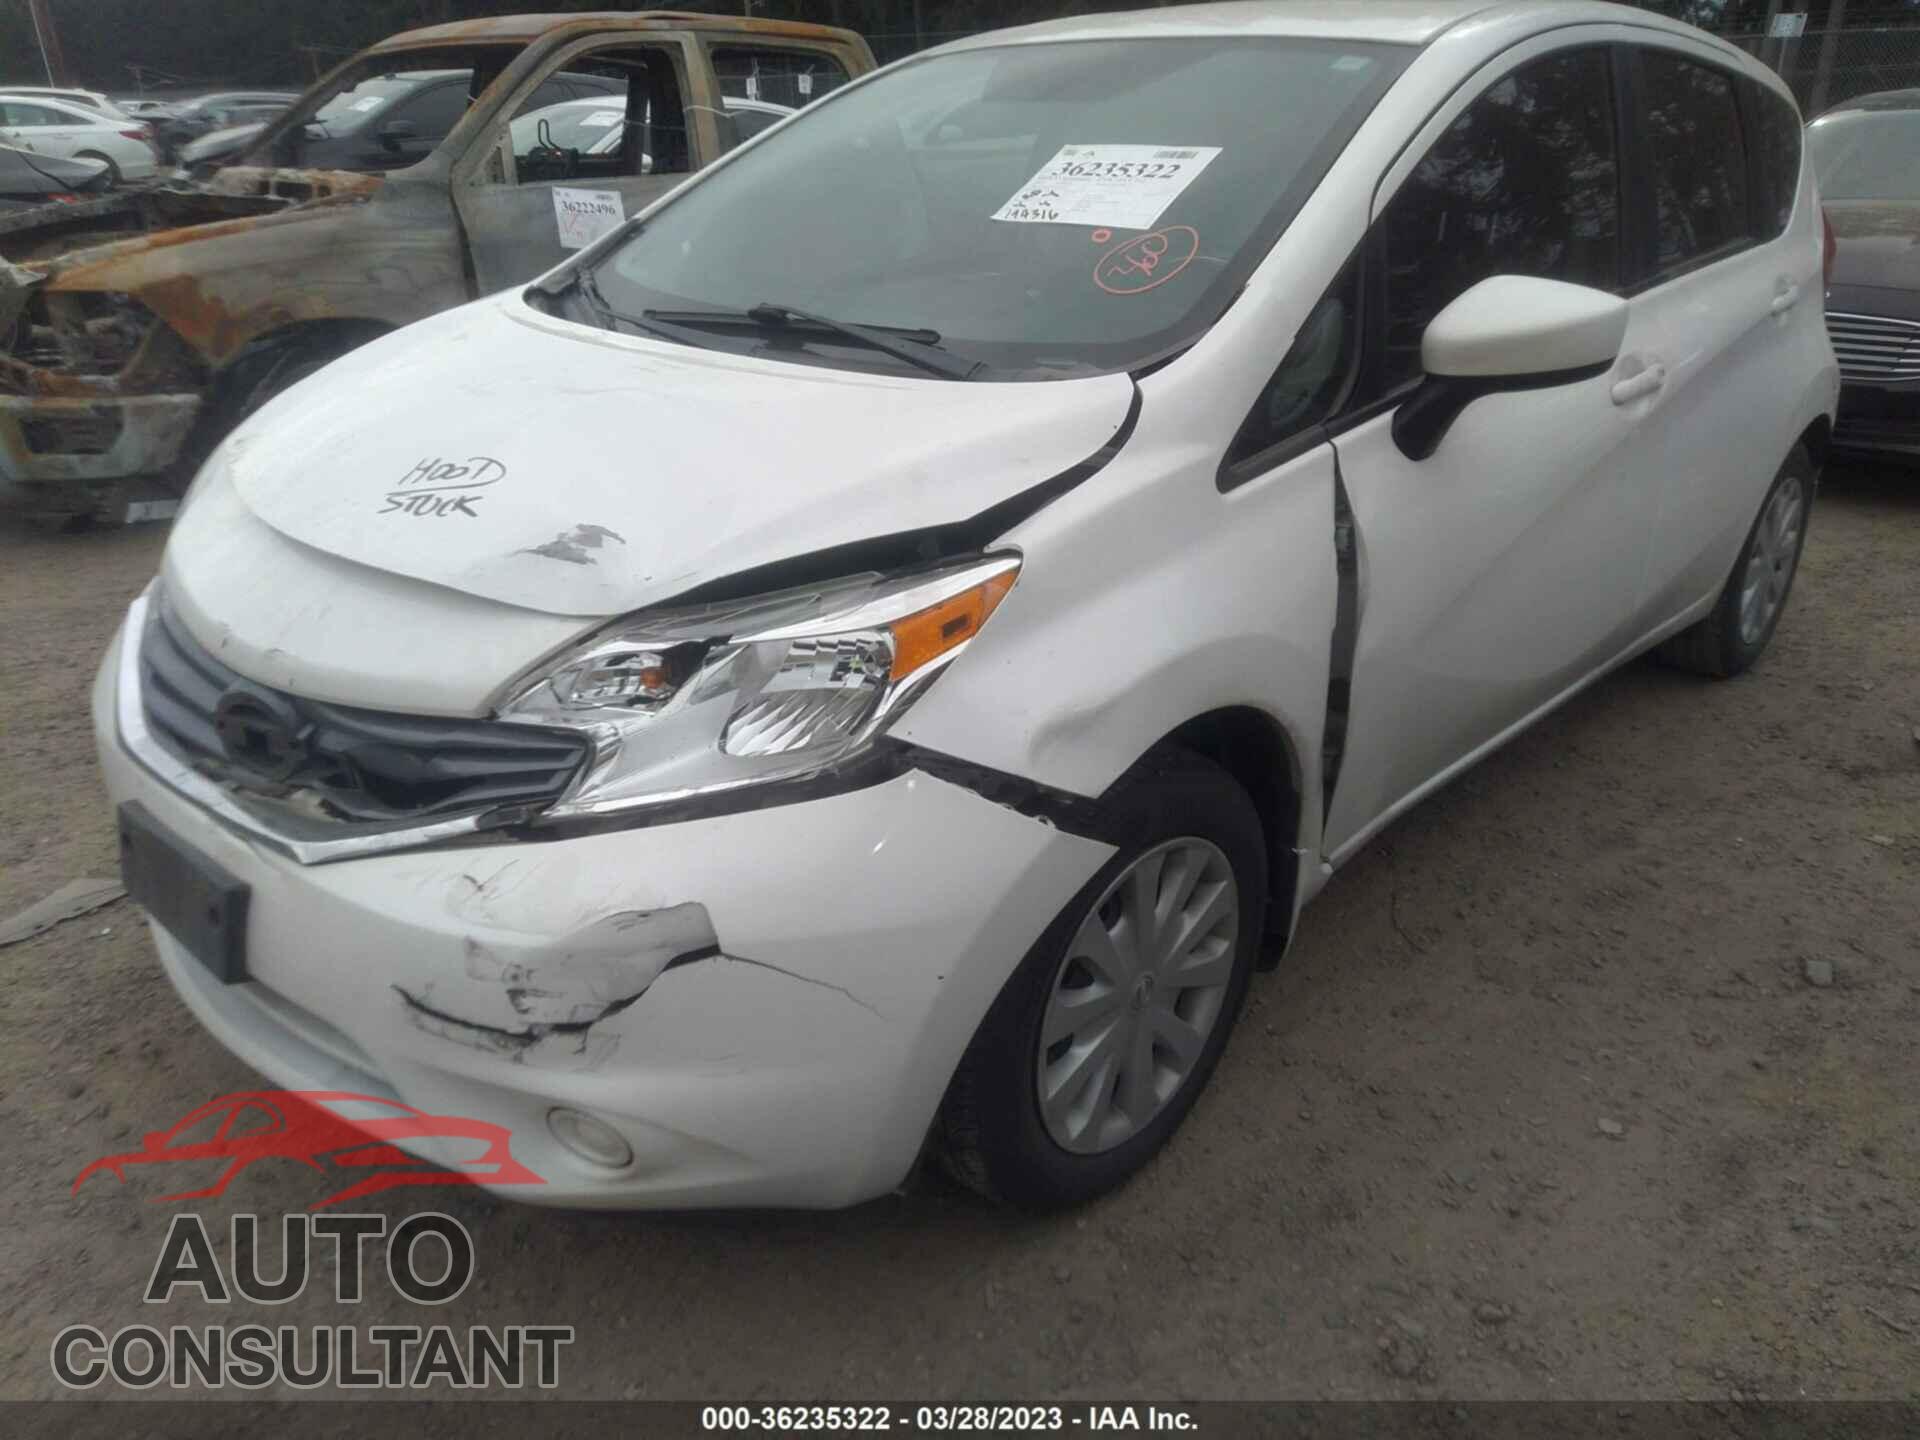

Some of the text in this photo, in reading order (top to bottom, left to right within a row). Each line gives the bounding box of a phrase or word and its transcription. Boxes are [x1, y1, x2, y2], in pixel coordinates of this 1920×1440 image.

[1052, 161, 1181, 178] 36235322
[560, 201, 616, 216] 36222496
[394, 456, 507, 487] HOOD
[377, 494, 484, 517] STUCK
